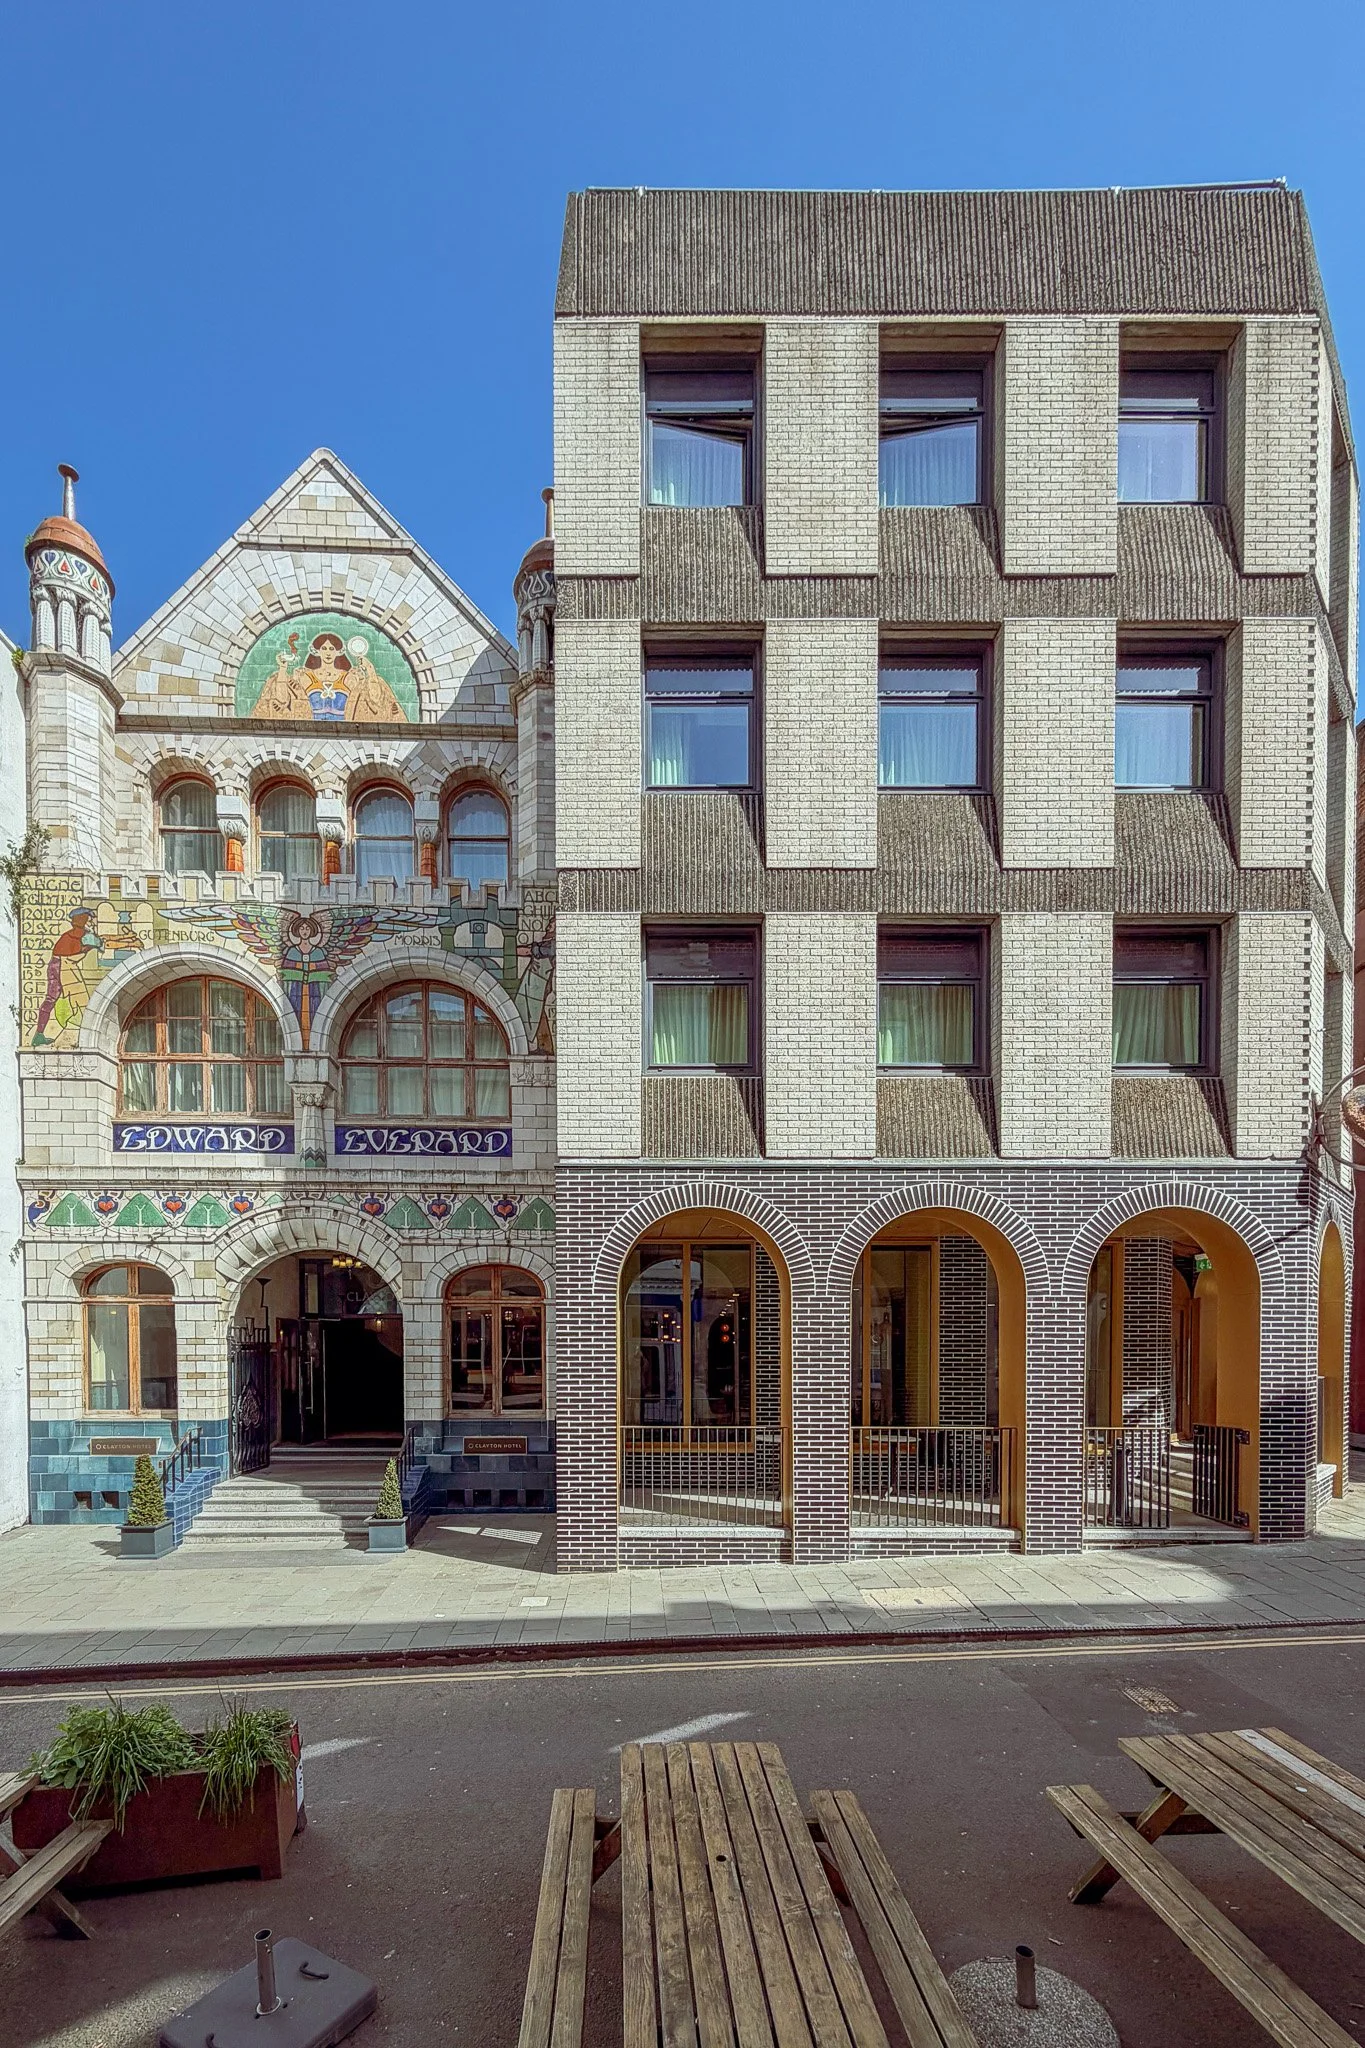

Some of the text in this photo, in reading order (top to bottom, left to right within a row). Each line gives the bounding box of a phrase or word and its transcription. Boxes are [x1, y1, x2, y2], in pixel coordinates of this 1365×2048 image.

[525, 890, 558, 902] ABC
[394, 935, 441, 946] MORRIS
[120, 1126, 285, 1151] EDWARD
[342, 1129, 508, 1153] EVERARD
